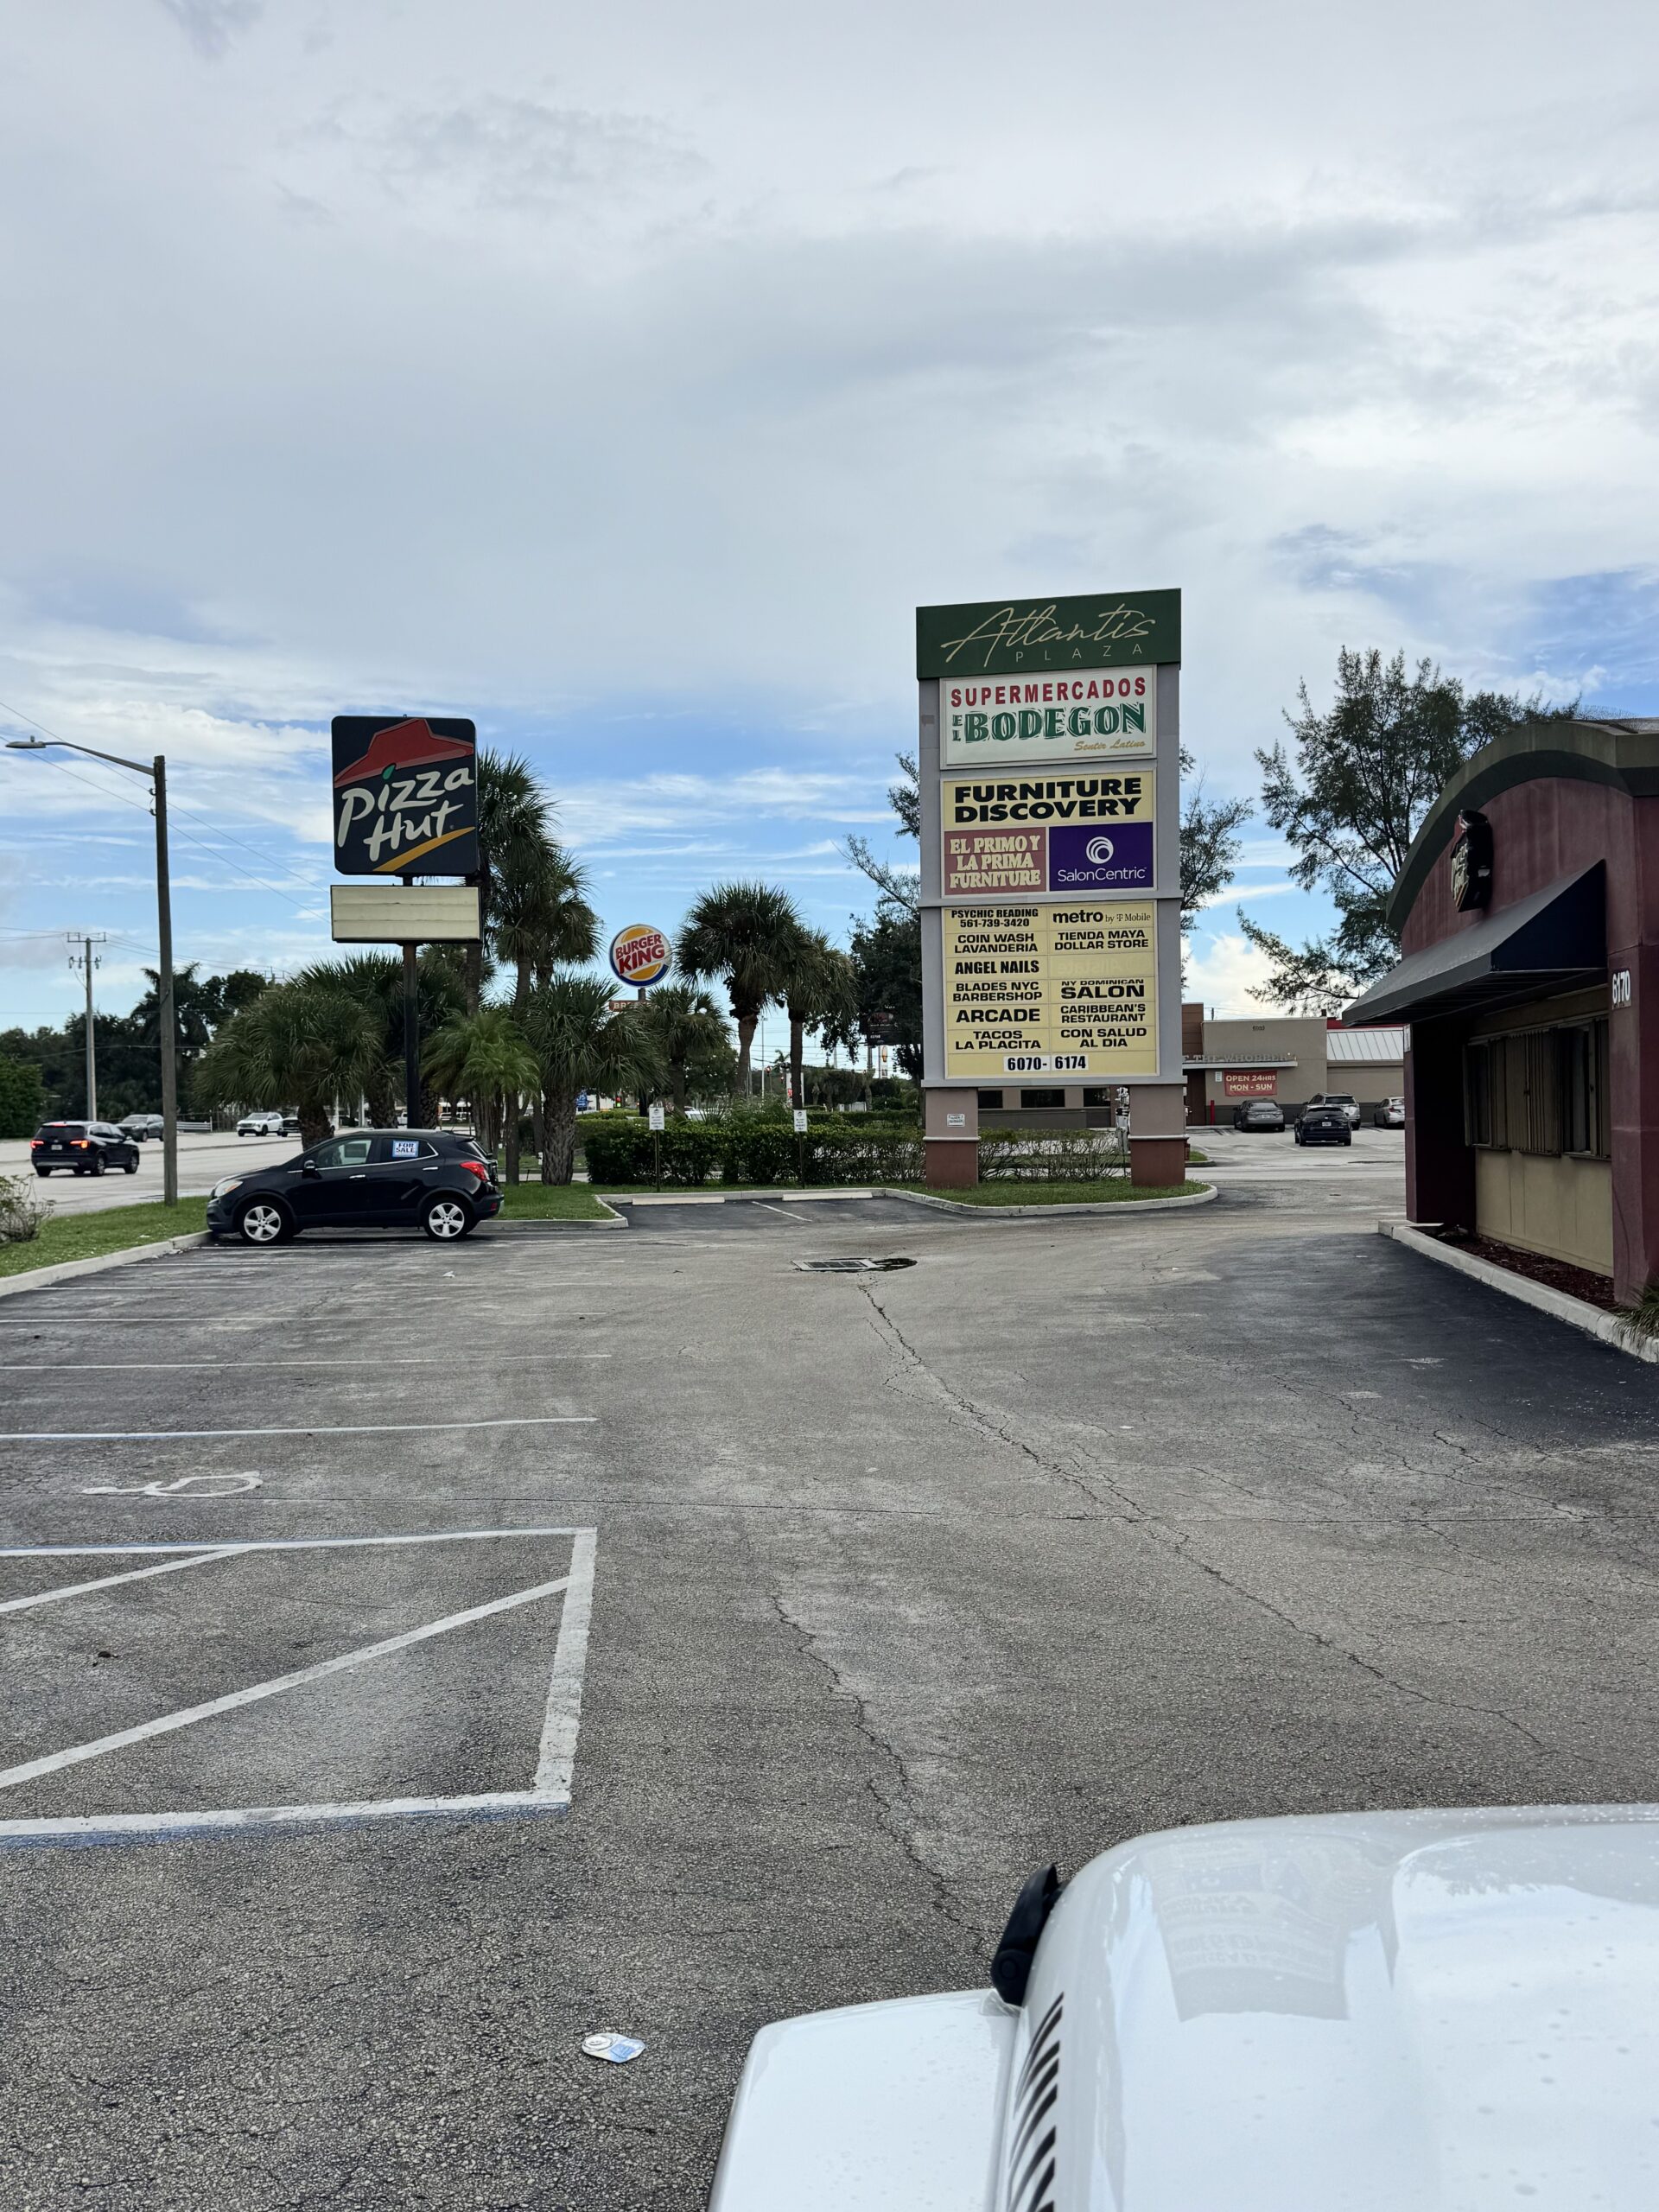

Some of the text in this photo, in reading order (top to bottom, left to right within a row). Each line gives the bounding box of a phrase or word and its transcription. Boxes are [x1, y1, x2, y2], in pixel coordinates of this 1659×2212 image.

[940, 602, 1156, 668] Atlantis
[1015, 643, 1142, 663] PLAZA
[950, 677, 1147, 708] SUPERMERCADOS
[964, 702, 1147, 744] BODEGON
[1109, 738, 1146, 748] Latino
[955, 777, 1141, 804] FURNITURE
[337, 766, 475, 848] Pizza
[955, 797, 1142, 823] DISCOVERY
[363, 799, 464, 862] Hut
[950, 835, 1040, 855] EL PRIMO Y
[957, 852, 1033, 872] LA PRIMA
[950, 869, 1041, 889] FURNITURE
[1058, 867, 1146, 882] SalonCentric
[951, 909, 1039, 918] PSYCHIC READING
[1052, 910, 1103, 924] metro
[1106, 914, 1115, 924] by
[960, 918, 1029, 927] 561-739-3420
[957, 933, 1034, 944] COIN WASH
[1058, 930, 1145, 940] TIENDA MAYA
[615, 934, 663, 960] BURGER
[954, 944, 1039, 953] LAVANDERIA
[1054, 939, 1149, 950] DOLLAR STORE
[619, 944, 665, 975] KING
[955, 960, 1039, 975] ANGEL NAILS
[956, 982, 1039, 991] BLADES NYC
[1061, 985, 1145, 999] SALON
[1612, 969, 1630, 1004] 6170
[952, 992, 1042, 1001] BARBERSHOP
[956, 1008, 1040, 1023] ARCADE
[1060, 1003, 1146, 1014] CARIBBEAN'S
[1061, 1014, 1146, 1023] RESTAURANT
[973, 1030, 1023, 1039] TACOS
[1060, 1027, 1147, 1038] CON SALUD
[955, 1040, 1041, 1050] LA PLACITA
[1079, 1039, 1128, 1047] AL DIA
[1007, 1055, 1086, 1071] 6070- 6174
